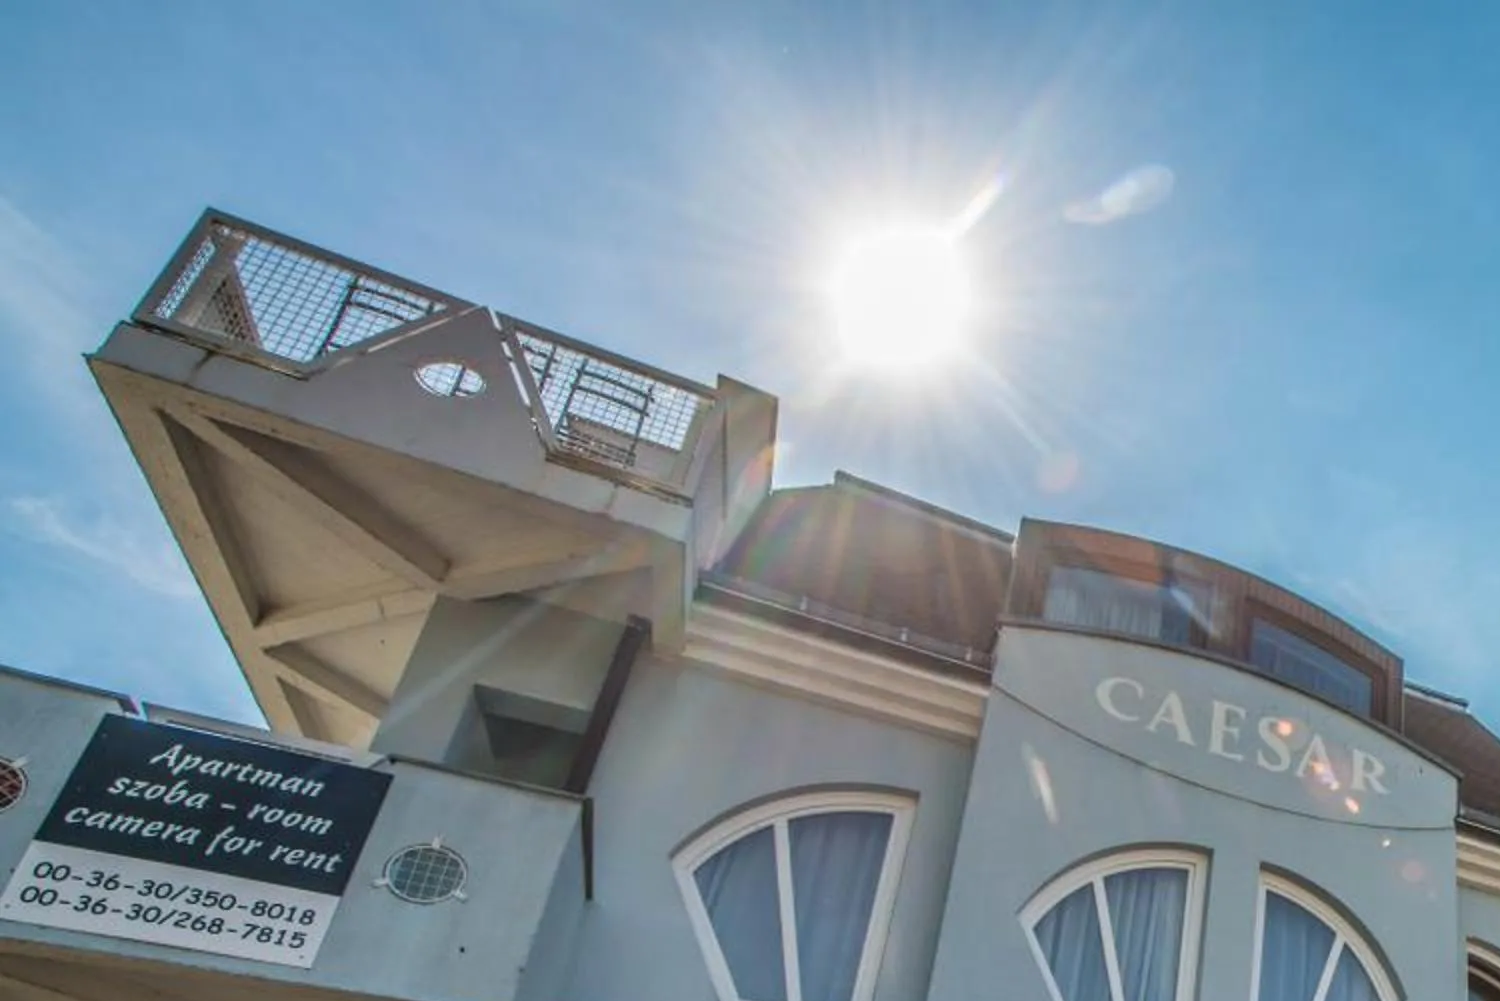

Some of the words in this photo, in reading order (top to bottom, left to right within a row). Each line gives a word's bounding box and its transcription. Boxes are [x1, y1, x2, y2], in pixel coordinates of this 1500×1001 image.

[1095, 676, 1390, 795] CAESAR
[151, 744, 325, 798] Apartman
[107, 776, 210, 810] szoba
[247, 801, 333, 836] room
[64, 806, 201, 845] camera
[205, 825, 263, 857] for
[269, 843, 344, 874] rent
[20, 885, 306, 950] 00-36-30/268-7815
[33, 861, 317, 926] 00-36-30/350-8018
